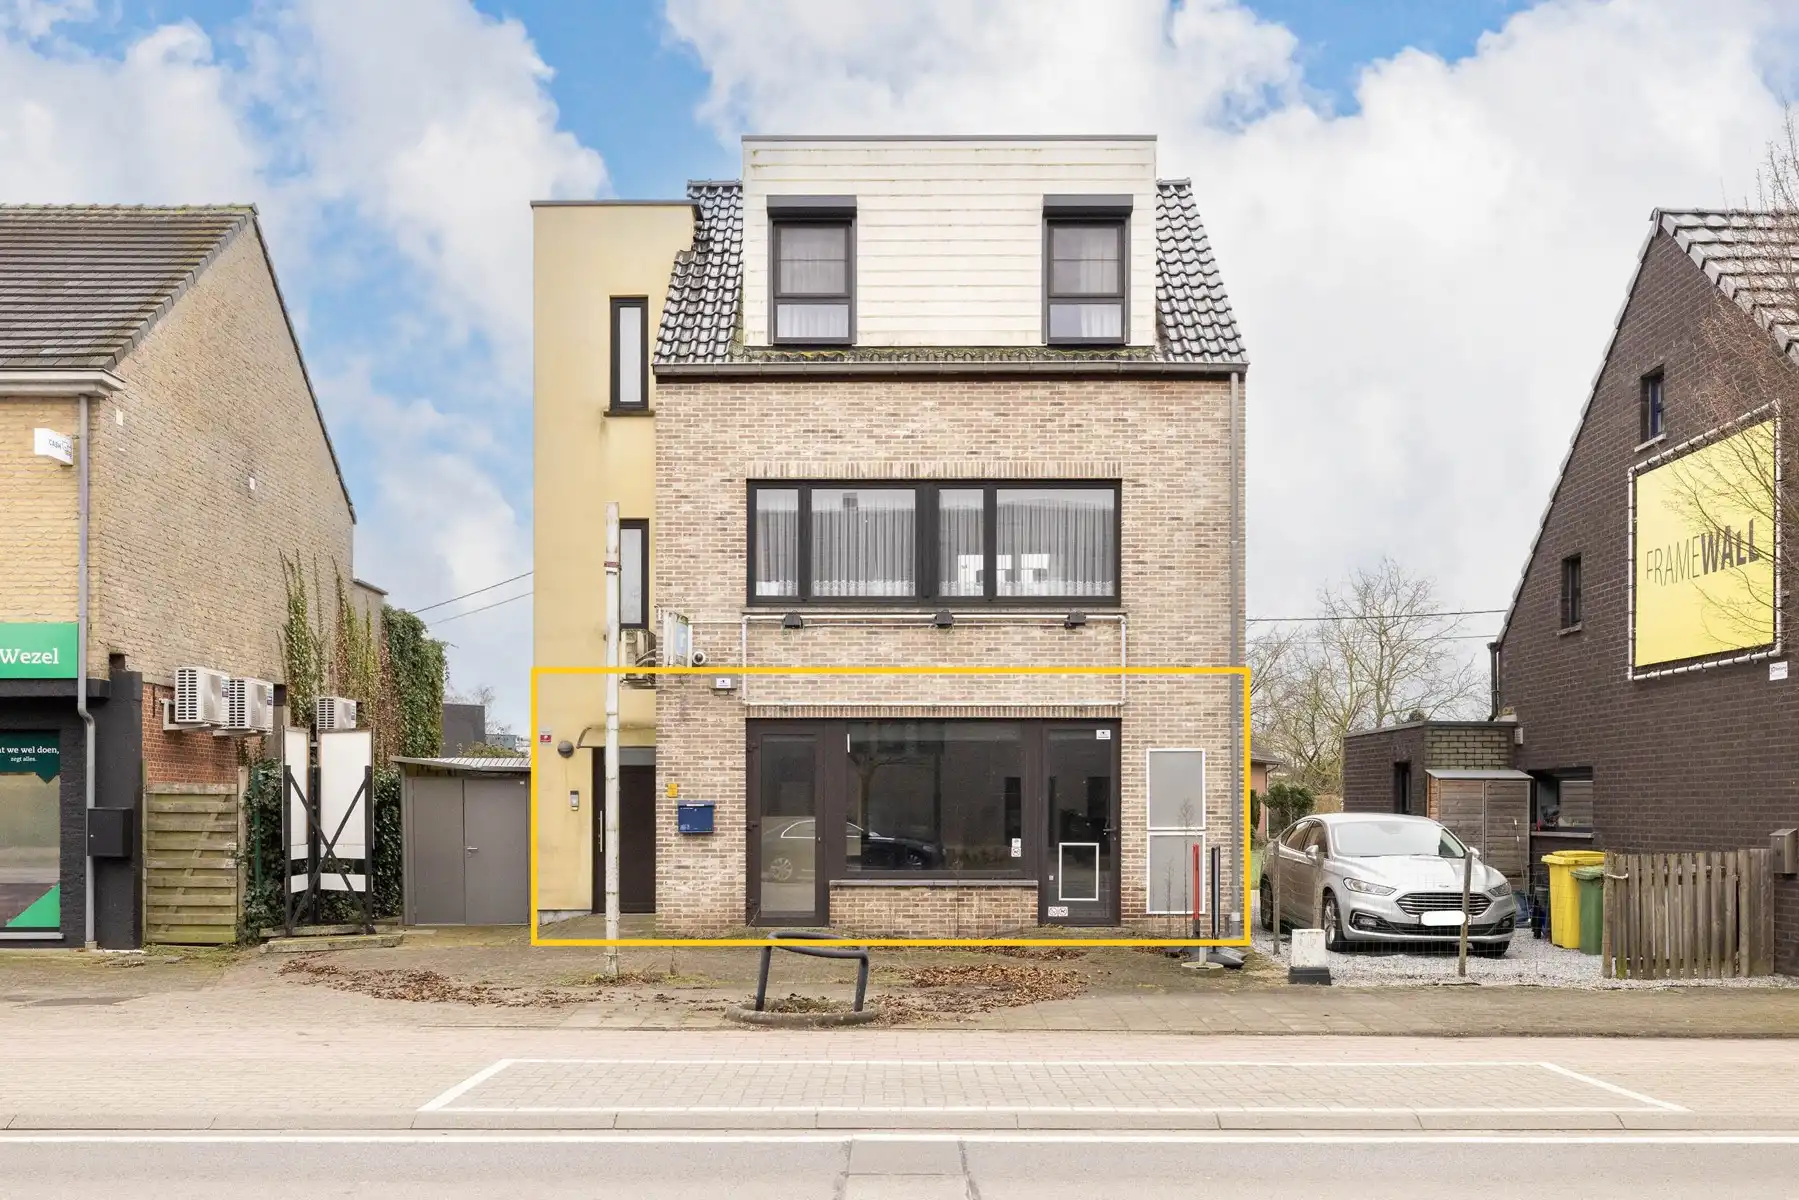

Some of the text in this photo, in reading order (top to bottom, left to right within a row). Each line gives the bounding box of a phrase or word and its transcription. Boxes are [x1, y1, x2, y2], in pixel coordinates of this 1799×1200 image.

[1646, 518, 1760, 586] FRAMEWALL
[0, 647, 60, 664] Wezel
[20, 745, 36, 754] wel
[37, 745, 60, 755] doen,
